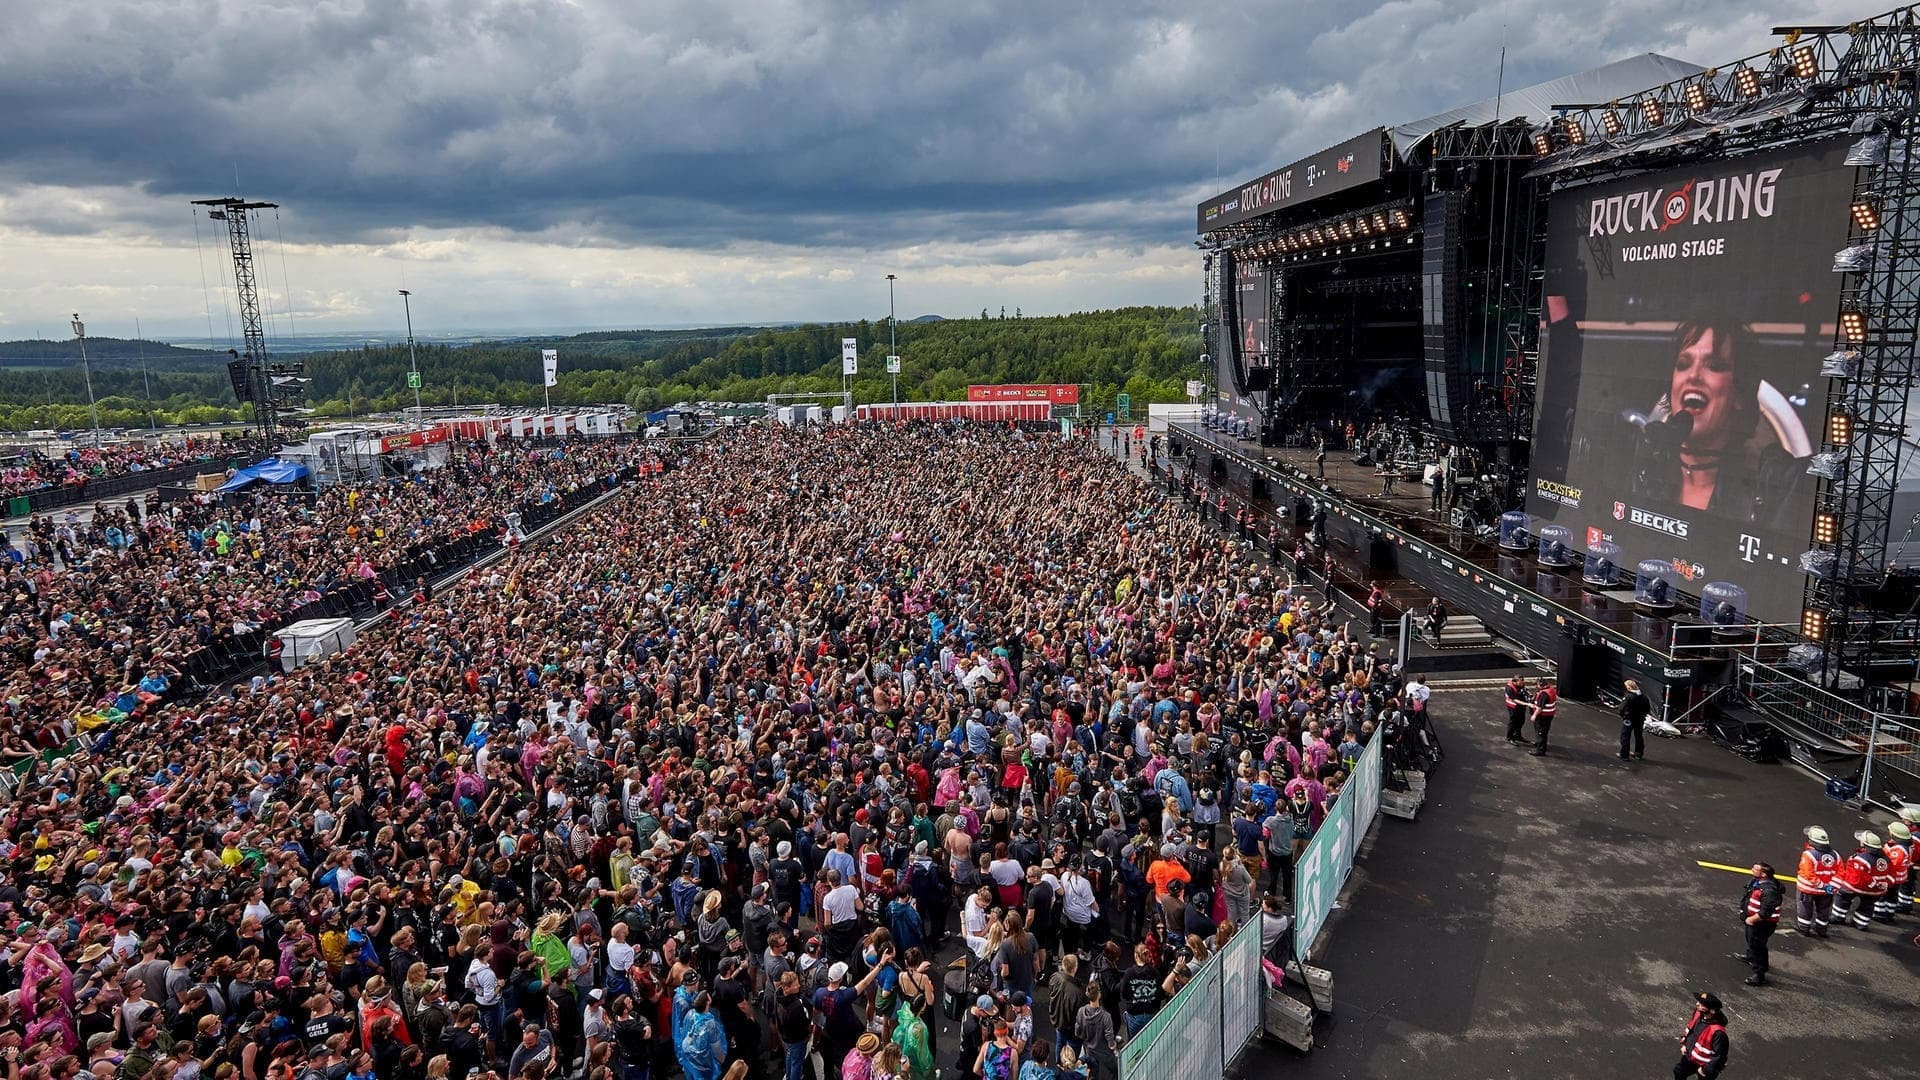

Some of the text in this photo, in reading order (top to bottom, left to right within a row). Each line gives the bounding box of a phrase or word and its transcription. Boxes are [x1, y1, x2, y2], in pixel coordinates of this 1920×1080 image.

[1241, 170, 1293, 213] ROCK RING
[1589, 188, 1664, 238] ROCK
[1692, 168, 1784, 225] RING
[1622, 238, 1725, 262] VOLCANO STAGE
[1536, 478, 1581, 500] ROCKSTAR
[1630, 509, 1689, 538] BECK'S
